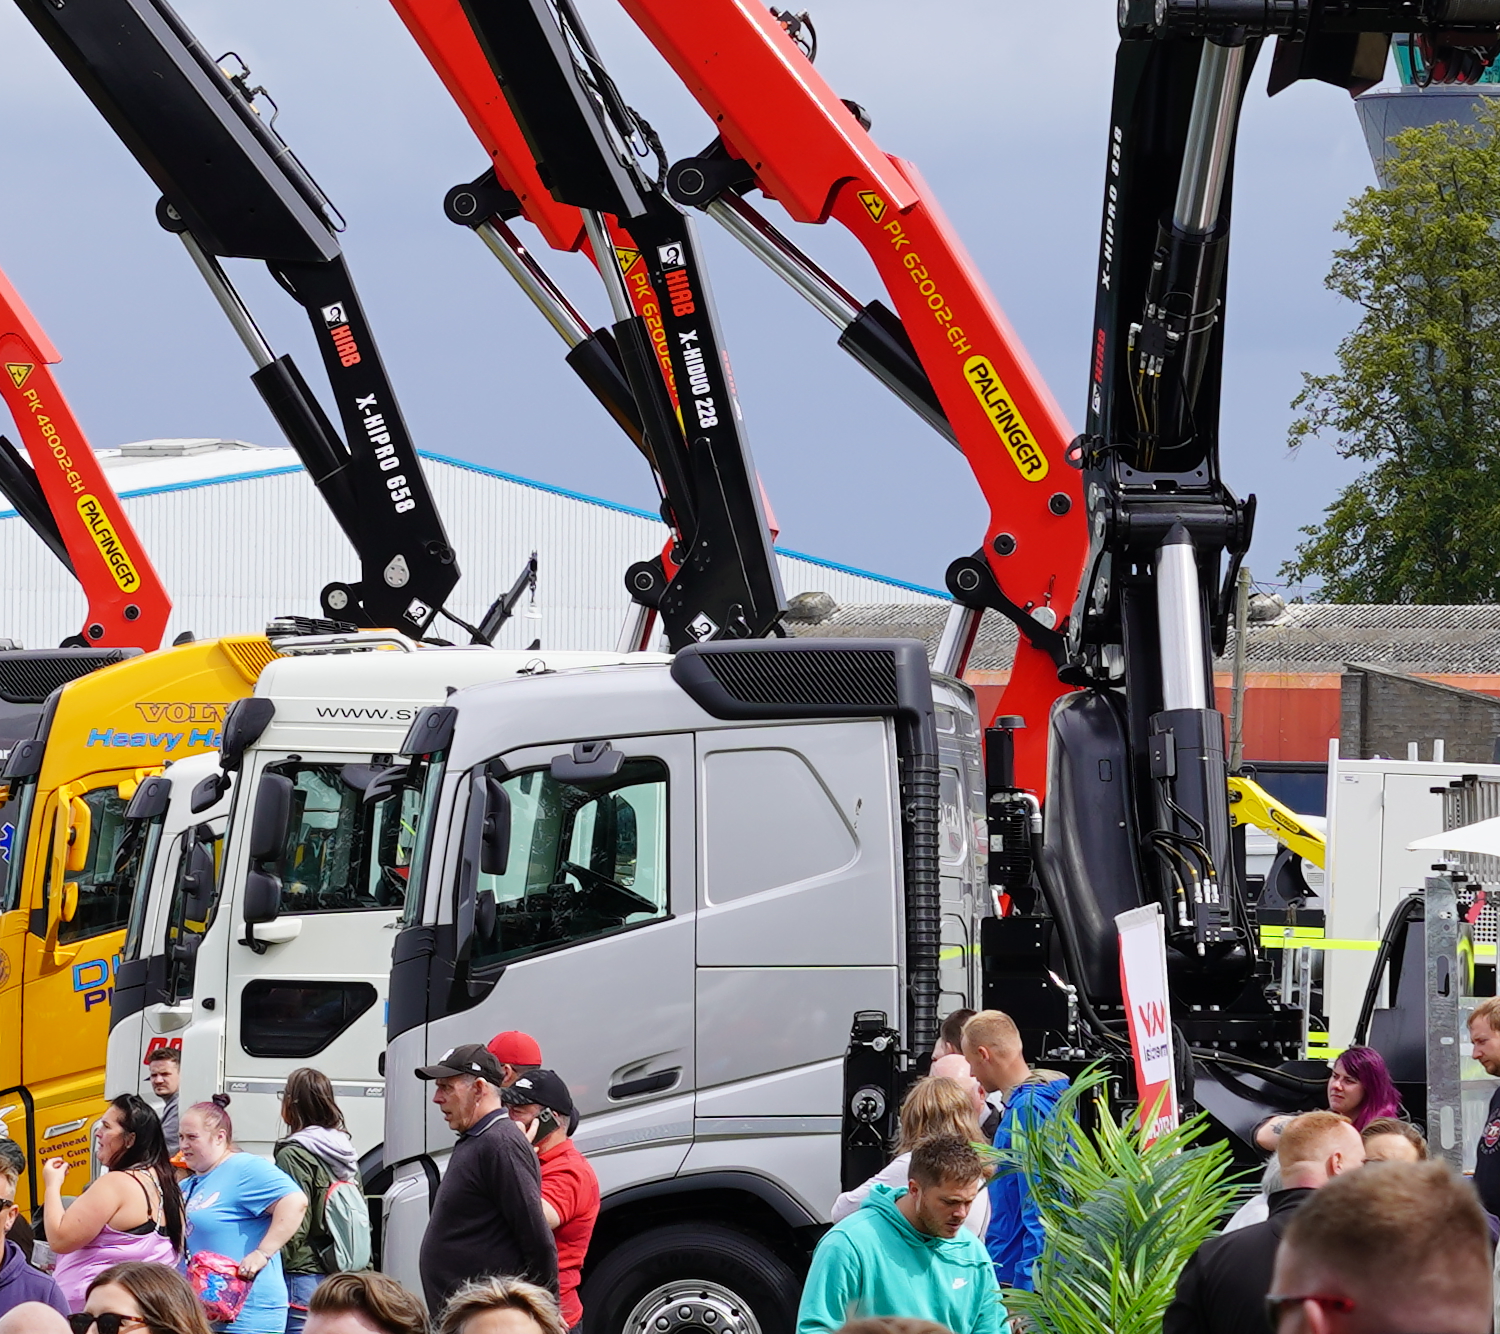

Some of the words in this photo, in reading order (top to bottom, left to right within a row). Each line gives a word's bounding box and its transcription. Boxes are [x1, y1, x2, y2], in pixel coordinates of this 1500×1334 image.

[630, 272, 652, 300] PK
[665, 269, 696, 317] HIAB
[883, 220, 910, 251] PK
[903, 252, 972, 356] 62002-EH
[331, 324, 362, 367] HIAB
[679, 329, 711, 396] X-HIDUO
[695, 397, 719, 429] 228
[22, 388, 44, 413] PK
[36, 415, 86, 495] 48002-EH
[355, 393, 400, 472] X-HIPRO
[386, 475, 416, 514] 658
[969, 362, 1042, 475] PALFINGER
[80, 500, 135, 588] PALFINGER
[85, 728, 184, 752] Heavy
[38, 1134, 88, 1155] Gatehead
